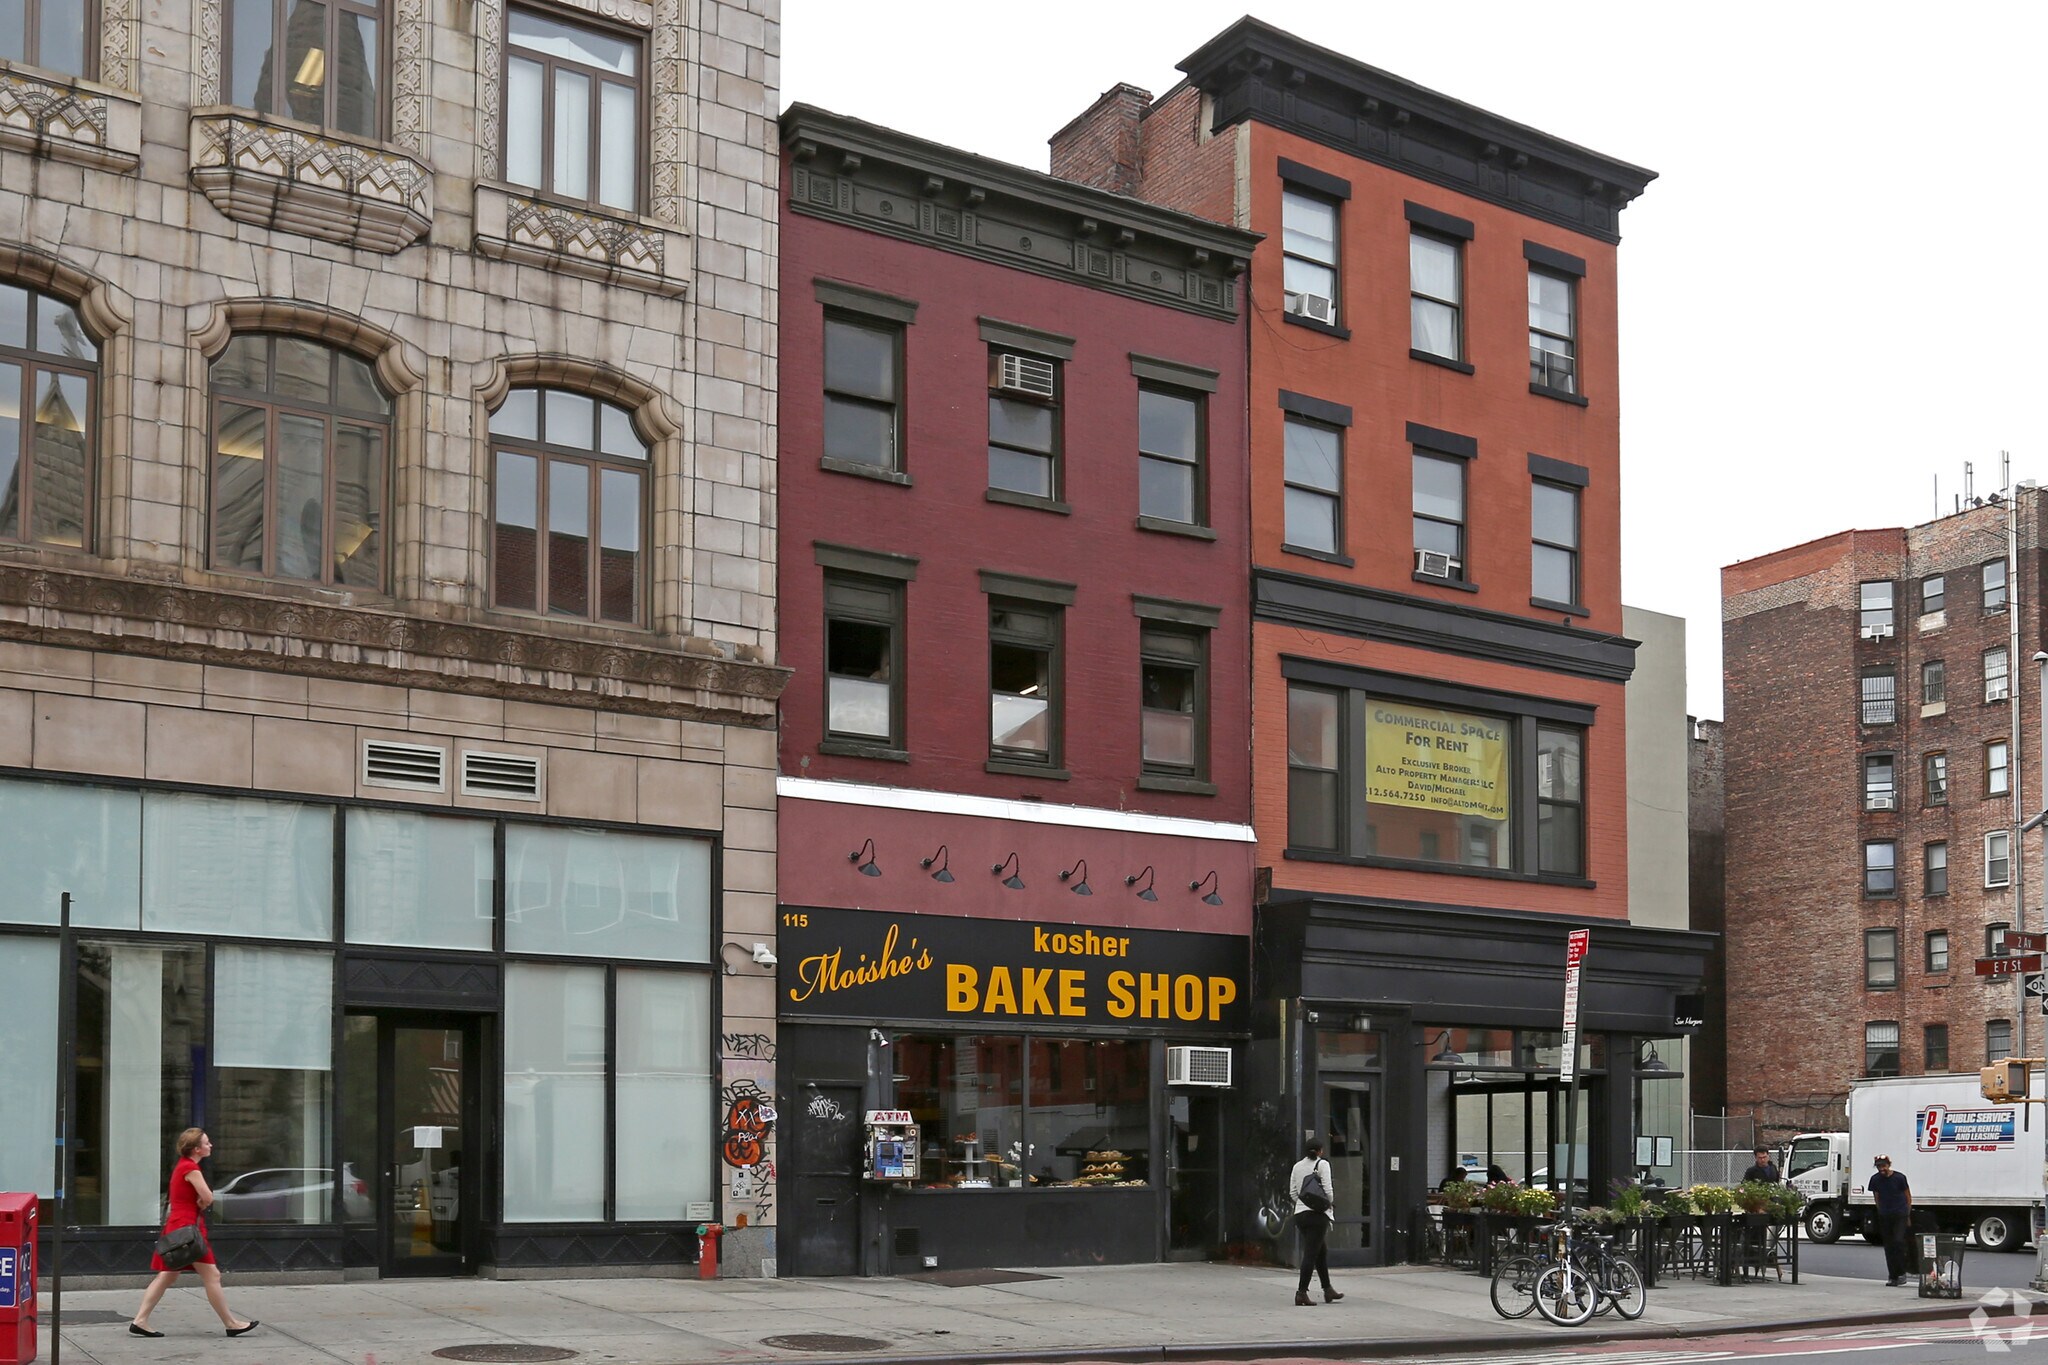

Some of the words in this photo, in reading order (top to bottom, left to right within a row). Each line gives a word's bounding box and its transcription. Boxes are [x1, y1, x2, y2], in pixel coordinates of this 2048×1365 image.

[1374, 709, 1457, 735] COMMERCIAL
[1460, 723, 1501, 742] SPACE
[1406, 731, 1431, 748] FOR
[1436, 736, 1469, 753] RENT
[1366, 787, 1426, 802] 12.564.7250
[783, 913, 809, 928] 115
[1034, 926, 1130, 958] kosher
[2017, 936, 2022, 948] 2
[2023, 937, 2032, 949] Av
[790, 923, 934, 1002] Moishe's
[1993, 961, 1999, 973] E
[2002, 961, 2008, 972] 7
[2011, 960, 2022, 972] St
[946, 963, 1087, 1017] BAKE
[1106, 970, 1238, 1021] SHOP
[2031, 981, 2046, 991] ON
[873, 1112, 909, 1122] ATM
[1946, 1113, 1977, 1124] PUBLIC
[1976, 1111, 2012, 1123] SERVICE
[1954, 1125, 1977, 1133] TRUCK
[1977, 1124, 2003, 1133] RENTAL
[1955, 1133, 1970, 1141] AND
[1970, 1132, 2000, 1141] LEASING
